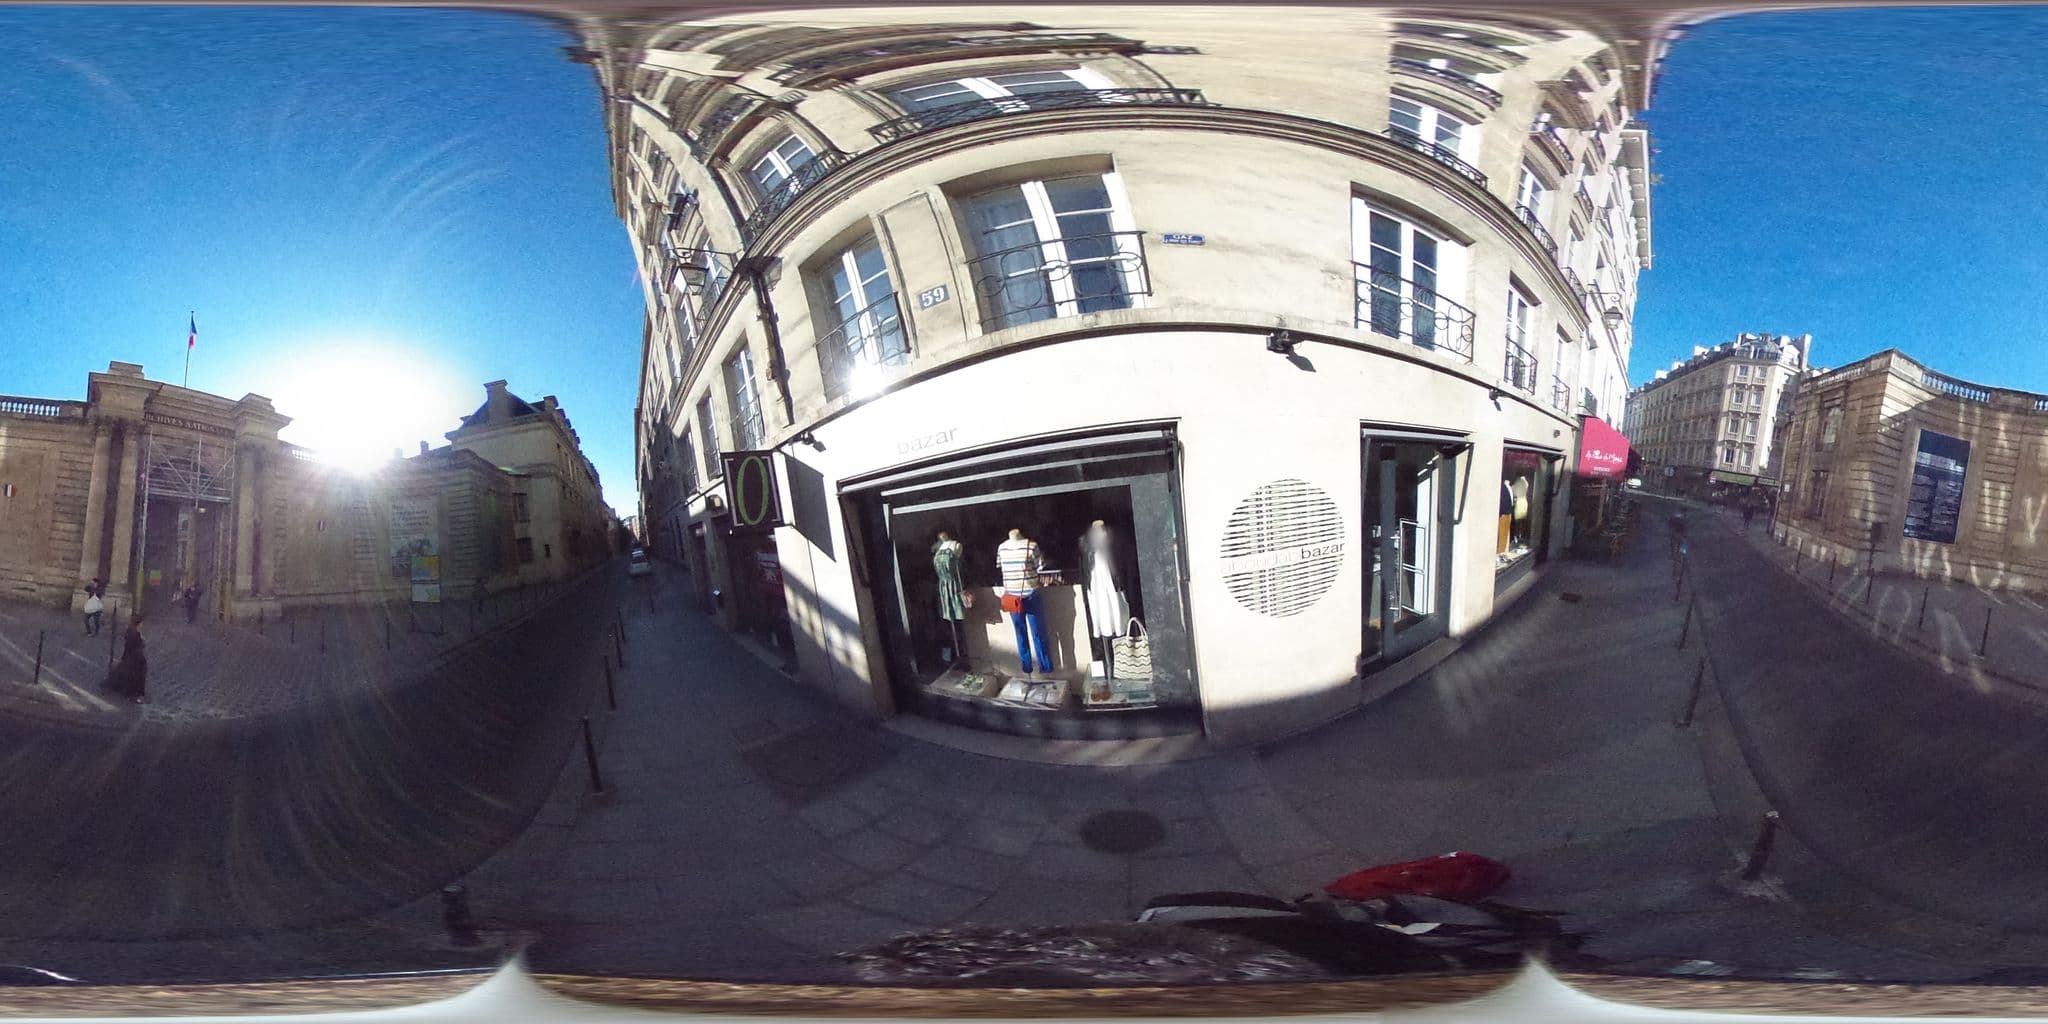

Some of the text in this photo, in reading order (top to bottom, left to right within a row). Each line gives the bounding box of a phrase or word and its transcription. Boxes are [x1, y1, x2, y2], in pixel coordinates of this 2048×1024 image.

[921, 287, 945, 307] 59
[897, 427, 958, 455] bazar
[1300, 542, 1345, 560] bazar
